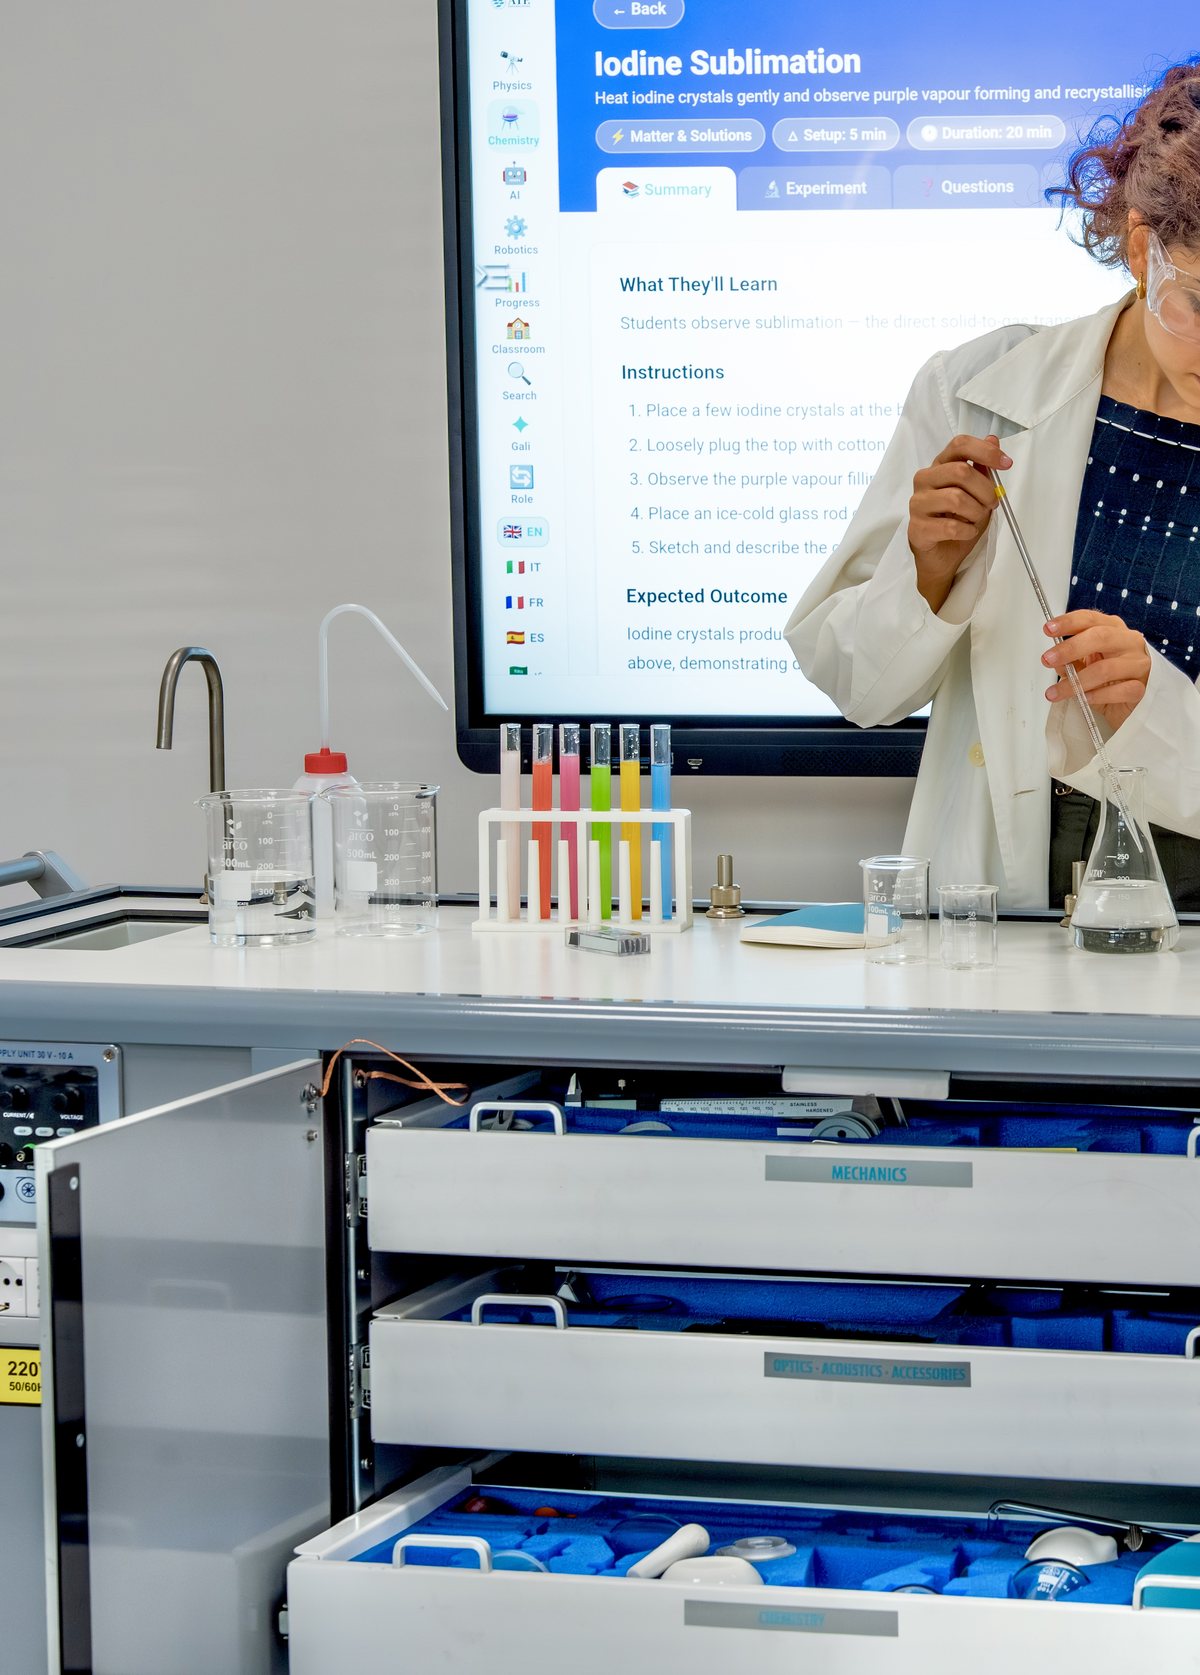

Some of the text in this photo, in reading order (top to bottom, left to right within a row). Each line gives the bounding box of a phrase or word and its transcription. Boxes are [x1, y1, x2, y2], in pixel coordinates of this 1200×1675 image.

[631, 1, 667, 16] Back
[595, 47, 861, 76] Iodine Sublimation
[493, 81, 532, 93] Physics
[595, 84, 1153, 106] Heat iodine crystals gently and observe purple vapour forming and recrystallisi
[631, 128, 752, 143] Matter & Solutions
[804, 127, 886, 144] Setup: 5 min
[942, 125, 1052, 140] Duration: 20 min
[488, 136, 539, 147] Chemistry
[644, 183, 711, 198] Summary
[786, 181, 867, 197] Experiment
[941, 180, 1014, 195] Questions
[510, 191, 520, 200] AI
[494, 245, 538, 255] Robotics
[619, 276, 778, 296] What They'll Learn
[495, 298, 540, 309] Progress
[620, 316, 687, 330] Students
[691, 316, 751, 330] observe
[755, 315, 843, 329] sublimation
[865, 314, 889, 329] the
[894, 314, 936, 328] direct
[492, 345, 545, 354] Classroom
[622, 364, 725, 380] Instructions
[502, 391, 537, 400] Search
[629, 402, 892, 420] 1. Place a few iodine crystals at the
[511, 442, 531, 451] Gali
[629, 438, 885, 455] 2. Loosely plug the top with cotton
[630, 471, 875, 488] 3. Observe the purple vapour filli
[511, 494, 534, 504] Role
[631, 506, 848, 523] 4. Place an ice-cold glass rod
[527, 527, 543, 537] EN
[631, 540, 827, 554] 5. Sketch and describe the
[530, 562, 541, 572] IT
[529, 598, 544, 607] FR
[627, 588, 788, 607] Expected Outcome
[530, 633, 545, 643] ES
[627, 627, 782, 644] Iodine crystals produ
[628, 656, 788, 673] above, demonstrating
[258, 837, 273, 845] 100
[349, 832, 374, 841] arco
[222, 841, 248, 850] arco
[220, 858, 251, 868] 500mL
[258, 862, 274, 870] 200
[18, 1050, 34, 1058] UNIT
[832, 1165, 907, 1182] MECHANICS
[8, 1361, 41, 1377] 220
[774, 1358, 966, 1381] OPTICS ACOUSTICS ACCESSORIES
